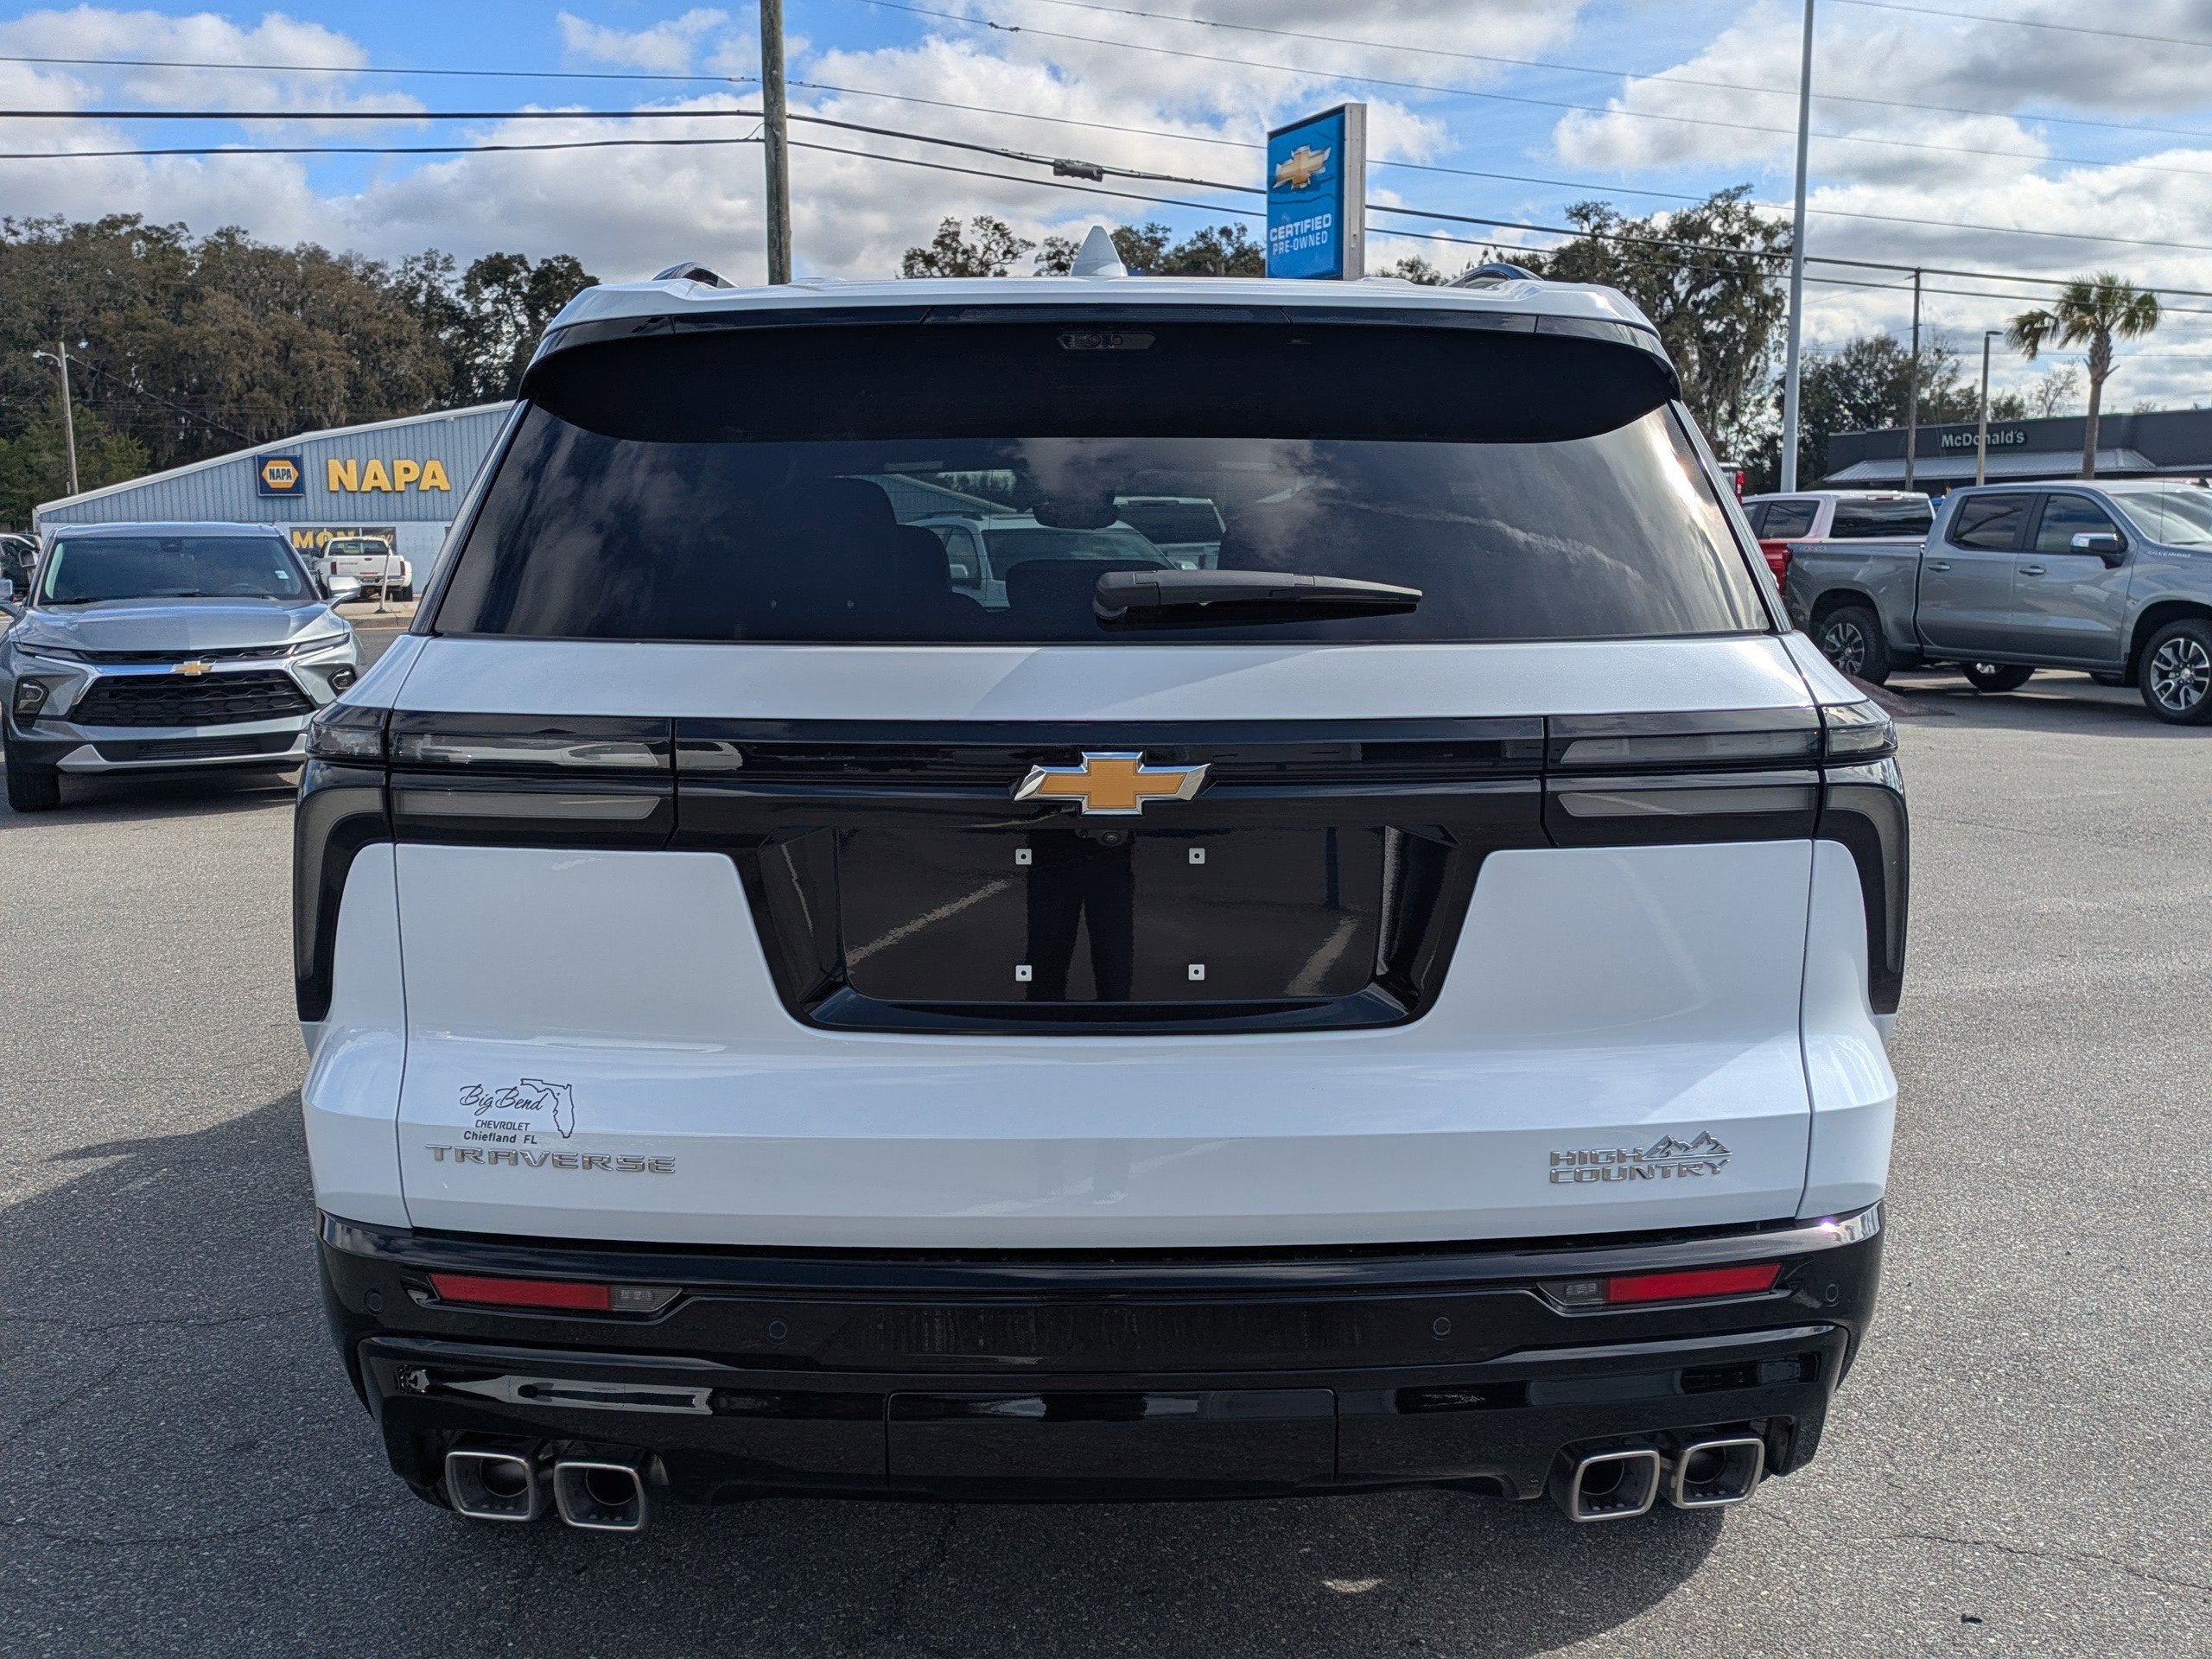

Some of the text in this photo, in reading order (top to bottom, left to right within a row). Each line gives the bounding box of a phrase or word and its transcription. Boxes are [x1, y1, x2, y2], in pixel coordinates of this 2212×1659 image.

[1269, 213, 1332, 242] CERTIFIED
[1273, 231, 1328, 256] PRE-OWNED
[1941, 429, 2025, 448] McDonald's
[269, 467, 292, 480] NAPA
[327, 459, 451, 492] NAPA
[459, 1084, 549, 1116] Big Bend
[475, 1119, 531, 1131] CHEVROLET
[463, 1131, 537, 1145] Chiefland FL
[424, 1144, 677, 1173] TRAVERSE
[1550, 1147, 1643, 1166] HIGH
[1549, 1159, 1731, 1183] COUNTRY
